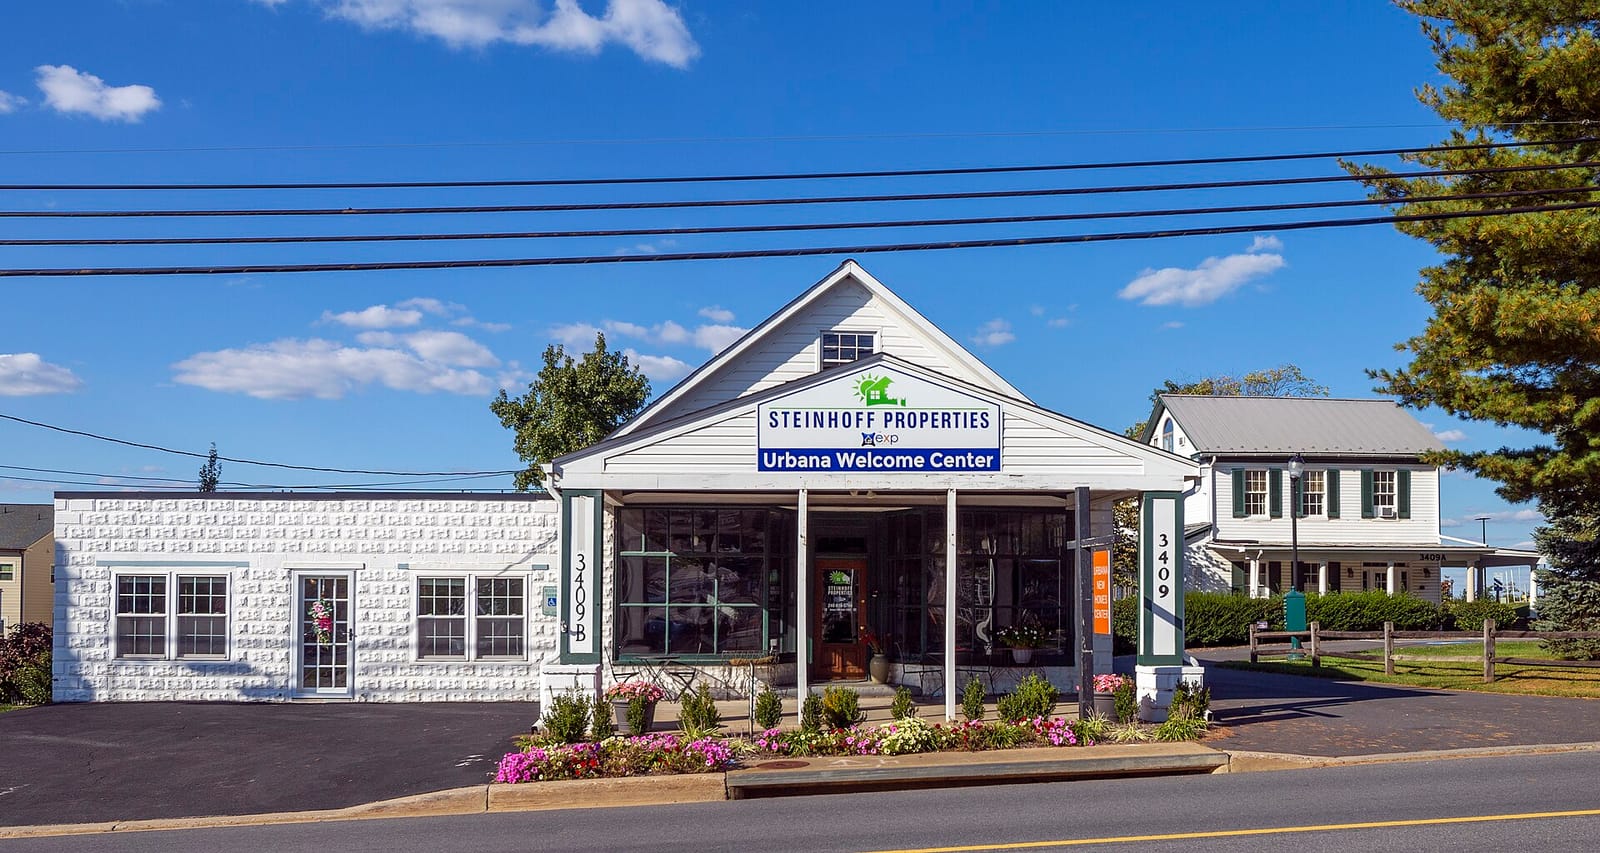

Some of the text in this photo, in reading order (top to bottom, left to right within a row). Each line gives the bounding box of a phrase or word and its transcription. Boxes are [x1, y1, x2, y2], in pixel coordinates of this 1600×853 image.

[769, 411, 990, 429] STEINHOFF PROPERTIES
[875, 434, 899, 445] exp
[763, 451, 994, 468] Urbana Welcome Center
[1419, 553, 1447, 561] 3409A
[1158, 533, 1170, 599] 3409
[574, 553, 586, 642] 3409B
